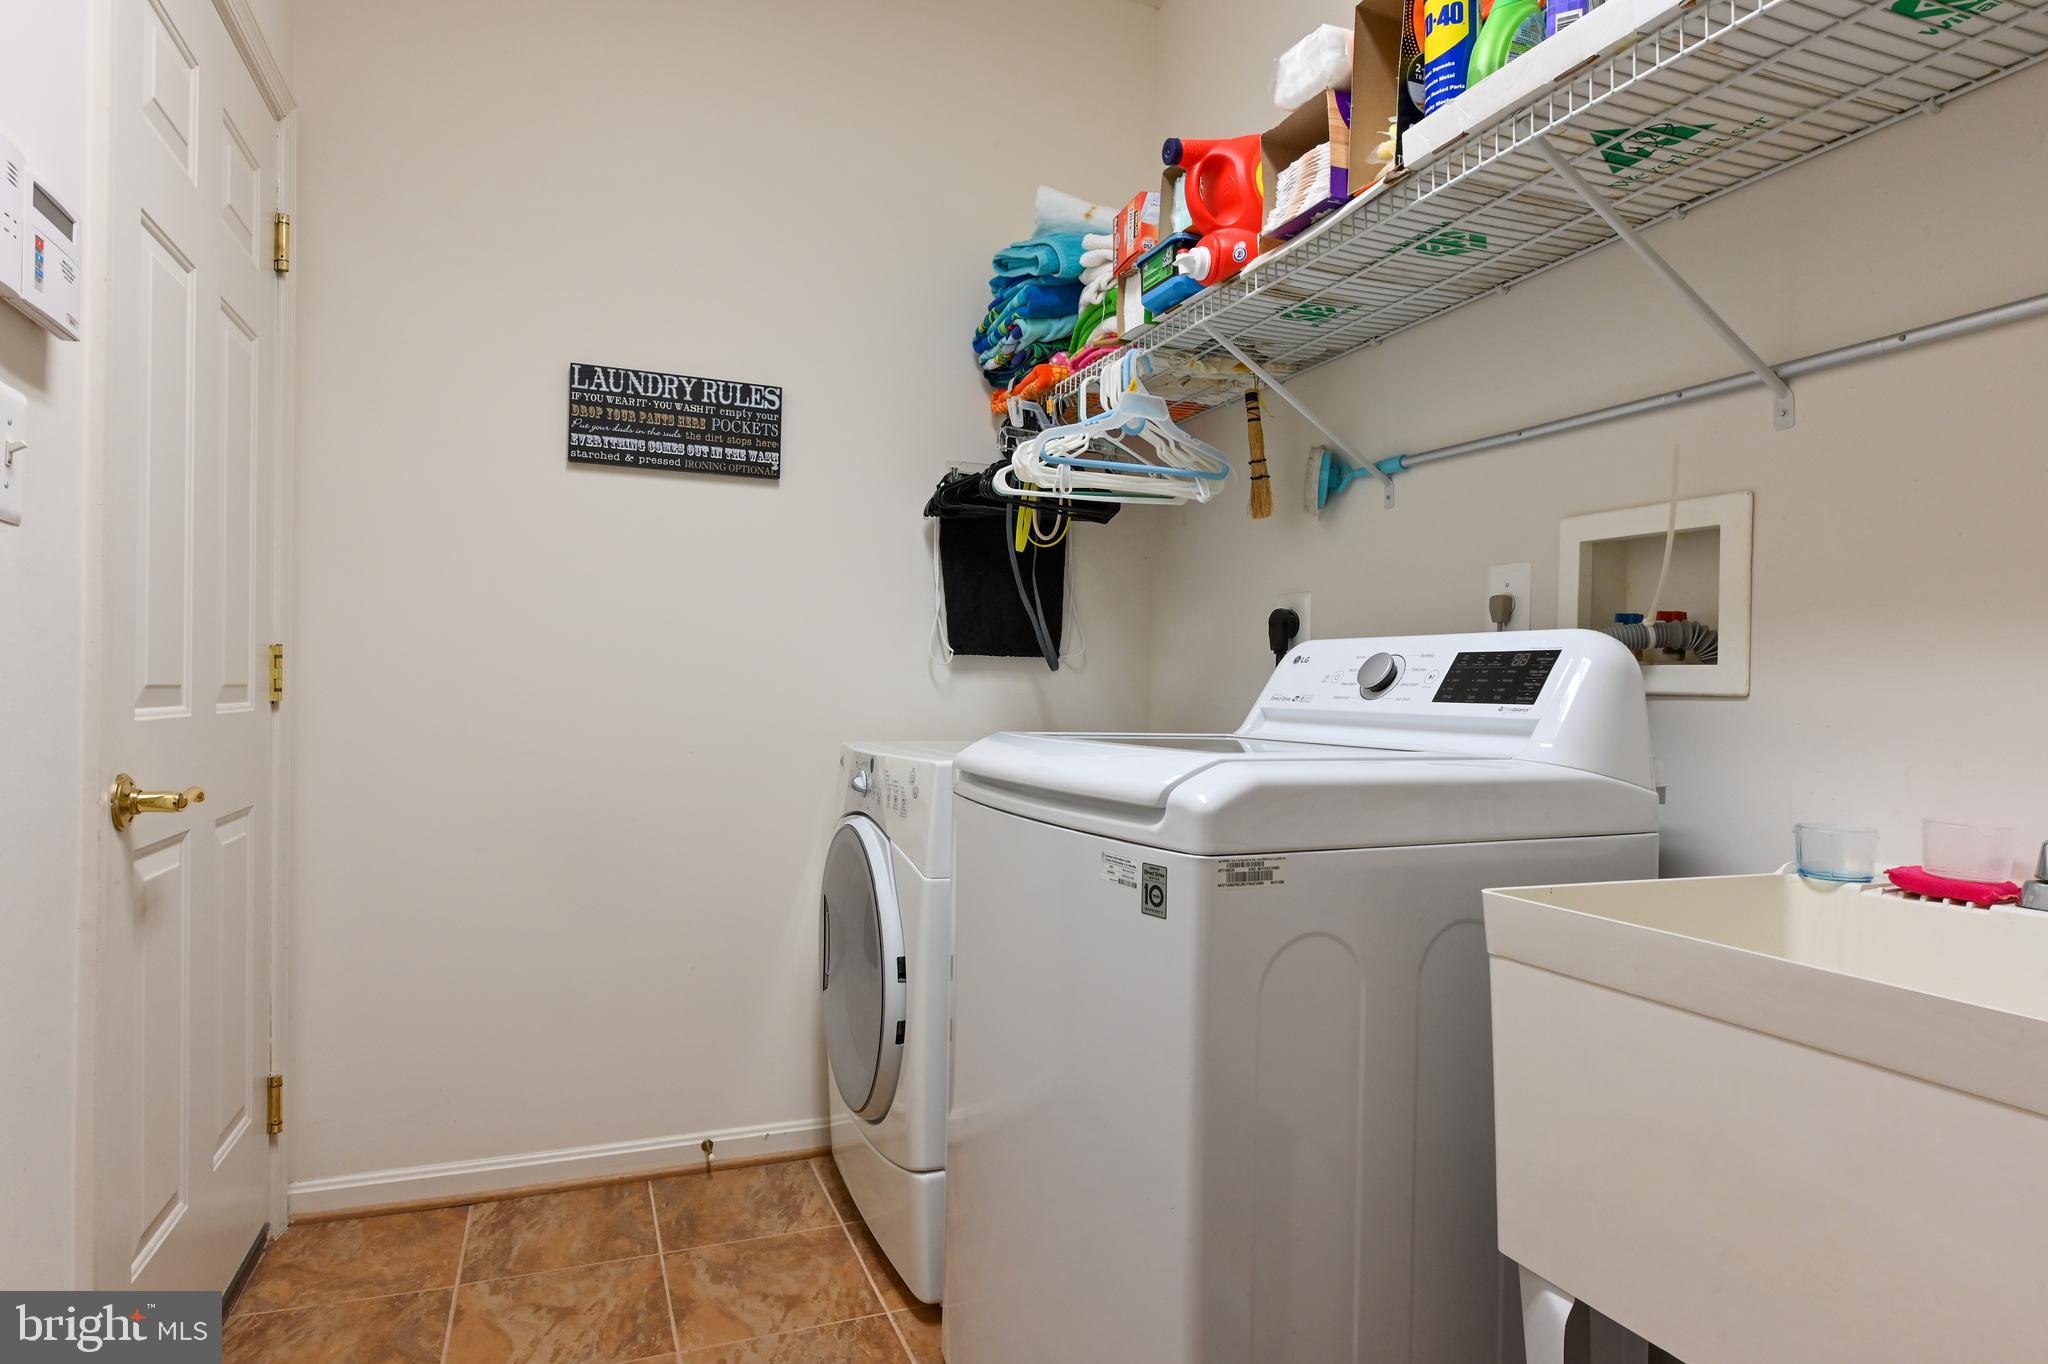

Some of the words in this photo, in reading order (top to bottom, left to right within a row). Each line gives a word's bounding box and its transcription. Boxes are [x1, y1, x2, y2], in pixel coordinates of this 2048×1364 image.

[1438, 72, 1456, 82] Metal
[1430, 86, 1449, 97] Rusted
[1449, 83, 1465, 91] Parts
[571, 364, 697, 401] LAUNDRY
[701, 379, 781, 411] RULES
[571, 391, 582, 400] IF
[583, 393, 604, 403] YOU
[606, 395, 636, 407] WEAR
[635, 399, 648, 408] IT
[653, 400, 673, 410] YOU
[674, 402, 704, 414] WASH
[704, 406, 717, 415] IT
[571, 403, 604, 419] DROP
[605, 407, 637, 423] YOUR
[639, 411, 675, 426] PANTS
[677, 415, 706, 430] HERE
[719, 408, 753, 420] empty
[755, 412, 779, 422] your
[589, 423, 611, 433] your
[612, 423, 634, 434] duds
[635, 427, 646, 435] in
[647, 427, 662, 437] the
[662, 429, 682, 439] suds
[711, 417, 779, 438] POCKETS
[685, 431, 702, 441] the
[704, 433, 724, 443] dirt
[726, 436, 753, 446] stops
[570, 432, 646, 452] EVERYTHING
[647, 440, 685, 456] COMES
[686, 444, 710, 458] OUT
[710, 446, 723, 459] IN
[724, 447, 747, 461] THE
[747, 450, 779, 464] WASH
[570, 449, 620, 462] starched
[624, 453, 635, 463] &
[638, 456, 681, 467] pressed
[684, 458, 727, 471] IRONING
[728, 463, 777, 476] OPTIONAL
[1300, 655, 1311, 664] LG
[1144, 882, 1164, 908] 10
